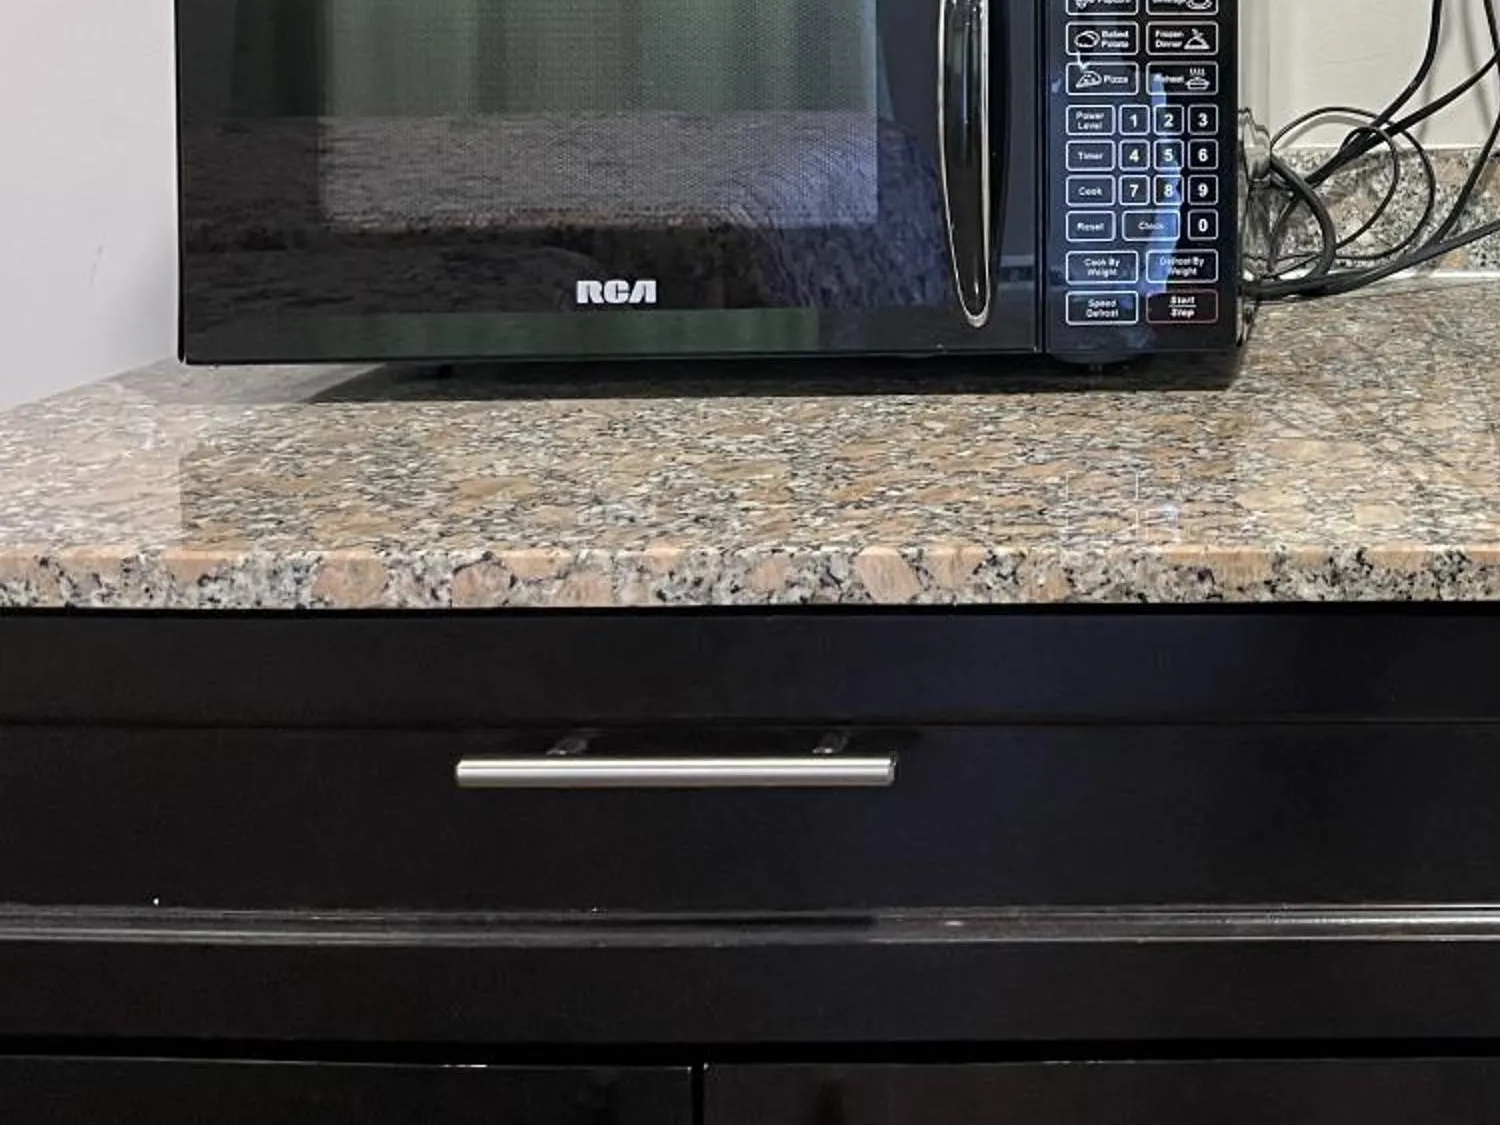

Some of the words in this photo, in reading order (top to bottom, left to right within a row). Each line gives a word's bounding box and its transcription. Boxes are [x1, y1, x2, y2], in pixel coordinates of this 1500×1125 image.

[1101, 30, 1129, 38] Baked
[1101, 40, 1129, 48] Potato
[1103, 74, 1129, 84] Pizza
[1076, 111, 1105, 120] Power
[1130, 114, 1138, 128] 1
[1163, 113, 1174, 128] 2
[1198, 113, 1209, 128] 3
[1077, 121, 1103, 130] Level
[1077, 151, 1104, 161] Timer
[1129, 148, 1140, 163] 4
[1163, 148, 1173, 163] 5
[1197, 148, 1209, 163] 6
[1077, 186, 1103, 197] Cook
[1129, 184, 1139, 198] 7
[1163, 184, 1174, 198] 8
[1197, 183, 1209, 198] 9
[1198, 218, 1209, 233] 0
[576, 280, 658, 305] RCA
[1088, 298, 1117, 309] Speed
[1170, 295, 1195, 305] Start
[1085, 308, 1119, 318] Defrost
